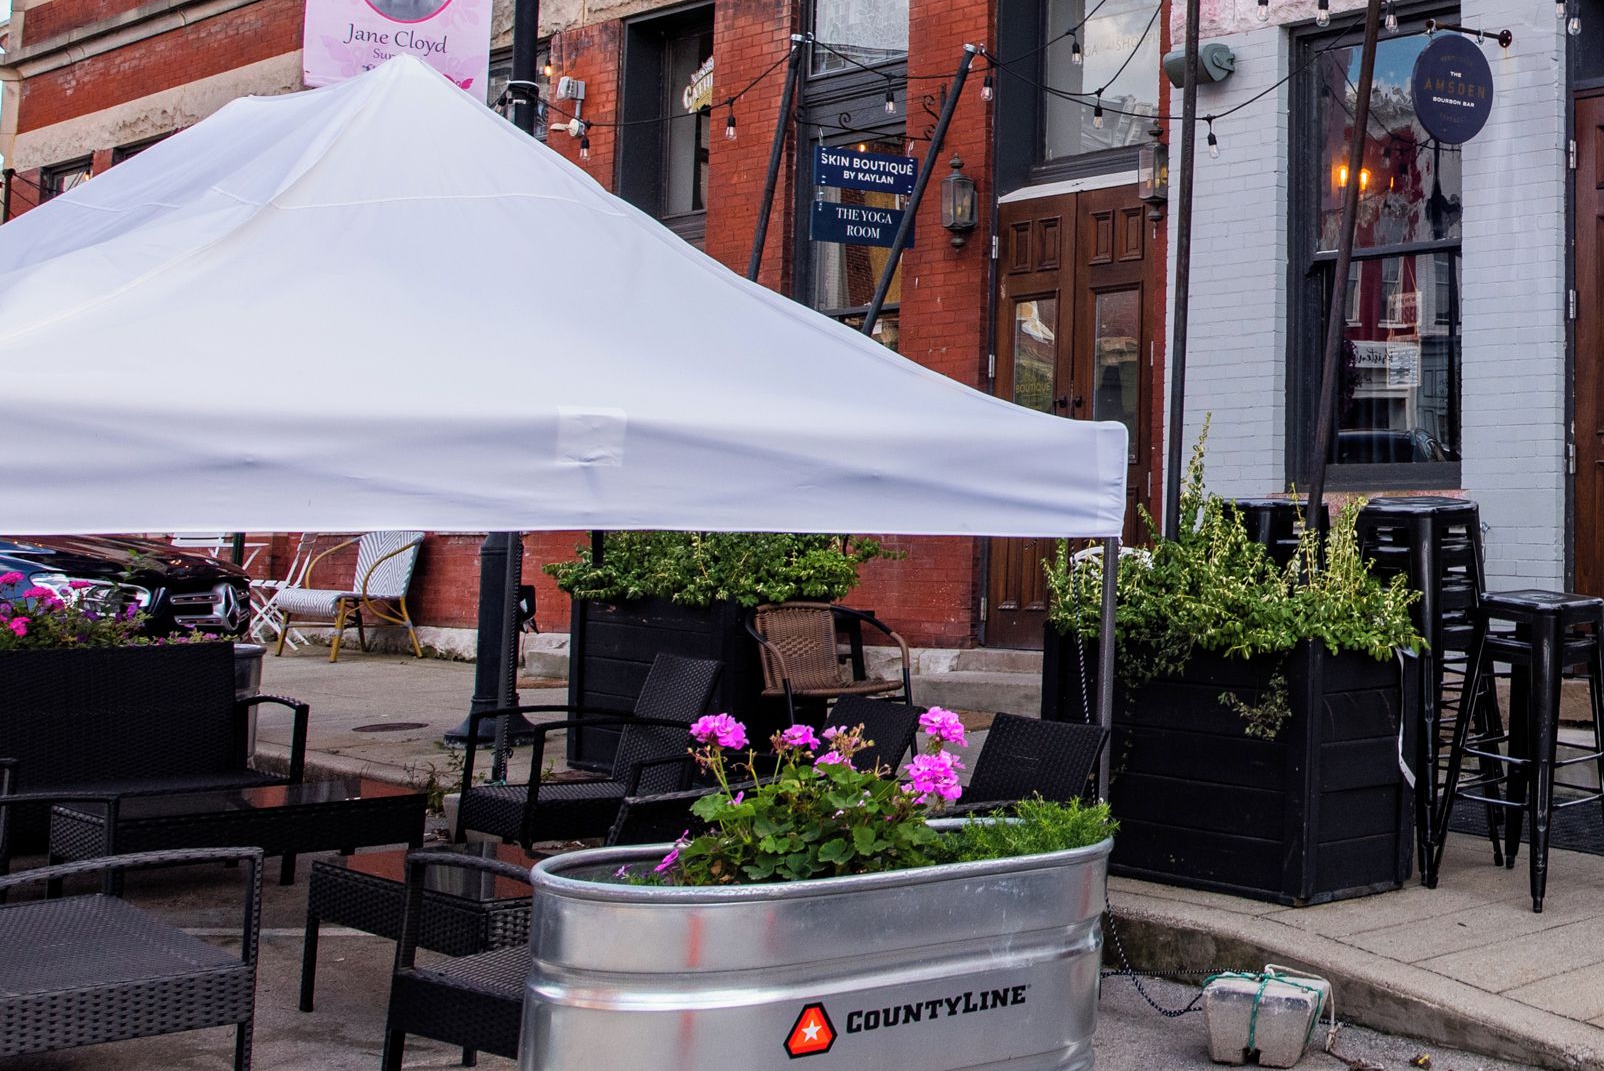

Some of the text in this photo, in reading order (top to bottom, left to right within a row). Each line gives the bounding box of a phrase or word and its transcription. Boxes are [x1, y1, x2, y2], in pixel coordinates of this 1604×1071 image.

[342, 23, 389, 45] Jane
[394, 30, 448, 57] Cloyd
[1424, 76, 1486, 100] AMSDEN
[1432, 96, 1475, 108] BOURBON BAR
[821, 152, 914, 176] SKIN BOUTIQUE
[843, 170, 894, 185] BY KAYLAN
[836, 207, 892, 225] THE YOGA
[846, 225, 880, 240] ROOM
